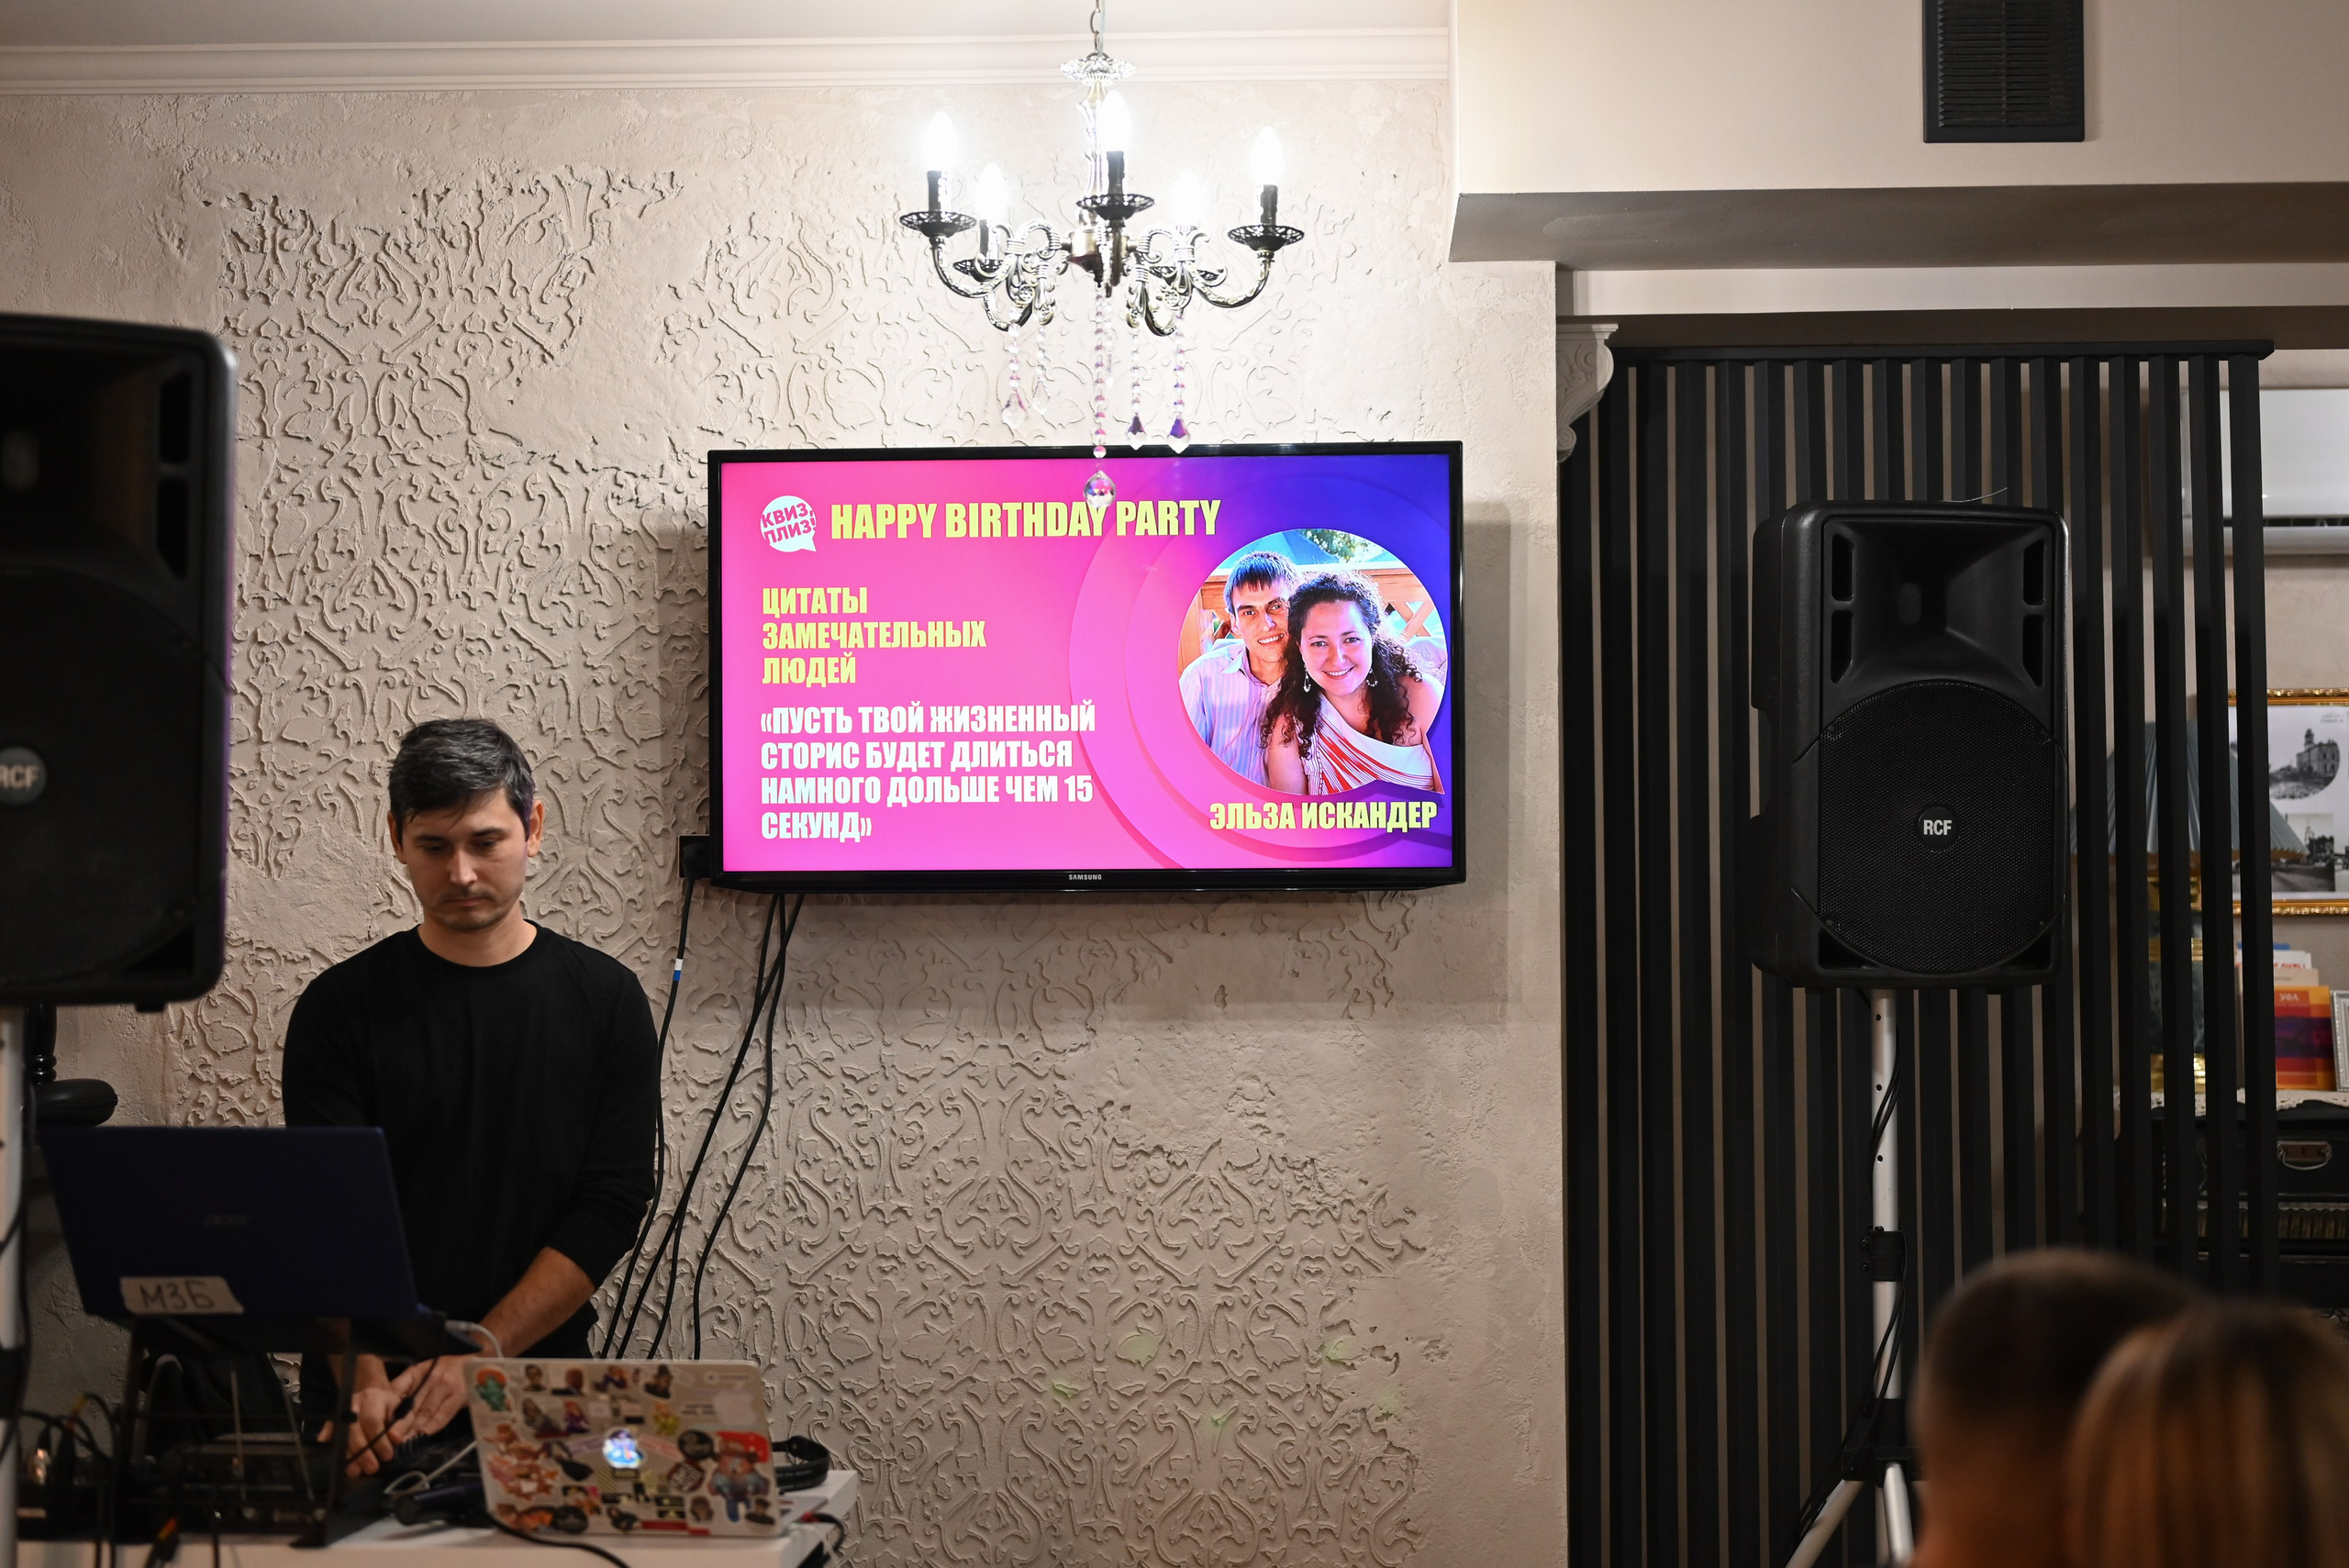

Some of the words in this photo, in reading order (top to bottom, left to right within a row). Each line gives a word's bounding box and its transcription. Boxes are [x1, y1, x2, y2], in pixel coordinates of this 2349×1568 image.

[830, 503, 938, 539] HAPPY
[945, 501, 1108, 539] BIRTHDAY
[1116, 499, 1221, 536] PARTY
[763, 587, 868, 618] ЦИТАТЫ
[763, 620, 987, 650] ЗАМЕЧАТЕЛЬНЫХ
[763, 651, 856, 688] ЛЮДЕЙ
[761, 706, 853, 735] «ПУСТЬ
[858, 700, 924, 733] ТВОЙ
[930, 699, 1096, 733] ЖИЗНЕННЫЙ
[761, 741, 860, 770] СТОРИС
[865, 741, 945, 773] БУДЕТ
[951, 740, 1073, 773] ДЛИТЬСЯ
[761, 776, 882, 805] НАМНОГО
[886, 775, 1000, 807] ДОЛЬШЕ
[1005, 775, 1059, 803] ЧЕМ
[1063, 774, 1094, 803] 15
[761, 811, 873, 843] СЕКУНД»
[1209, 803, 1297, 829] ЭЛЬЗА
[1301, 801, 1438, 833] ИСКАНДЕР
[1923, 819, 1953, 836] RCF
